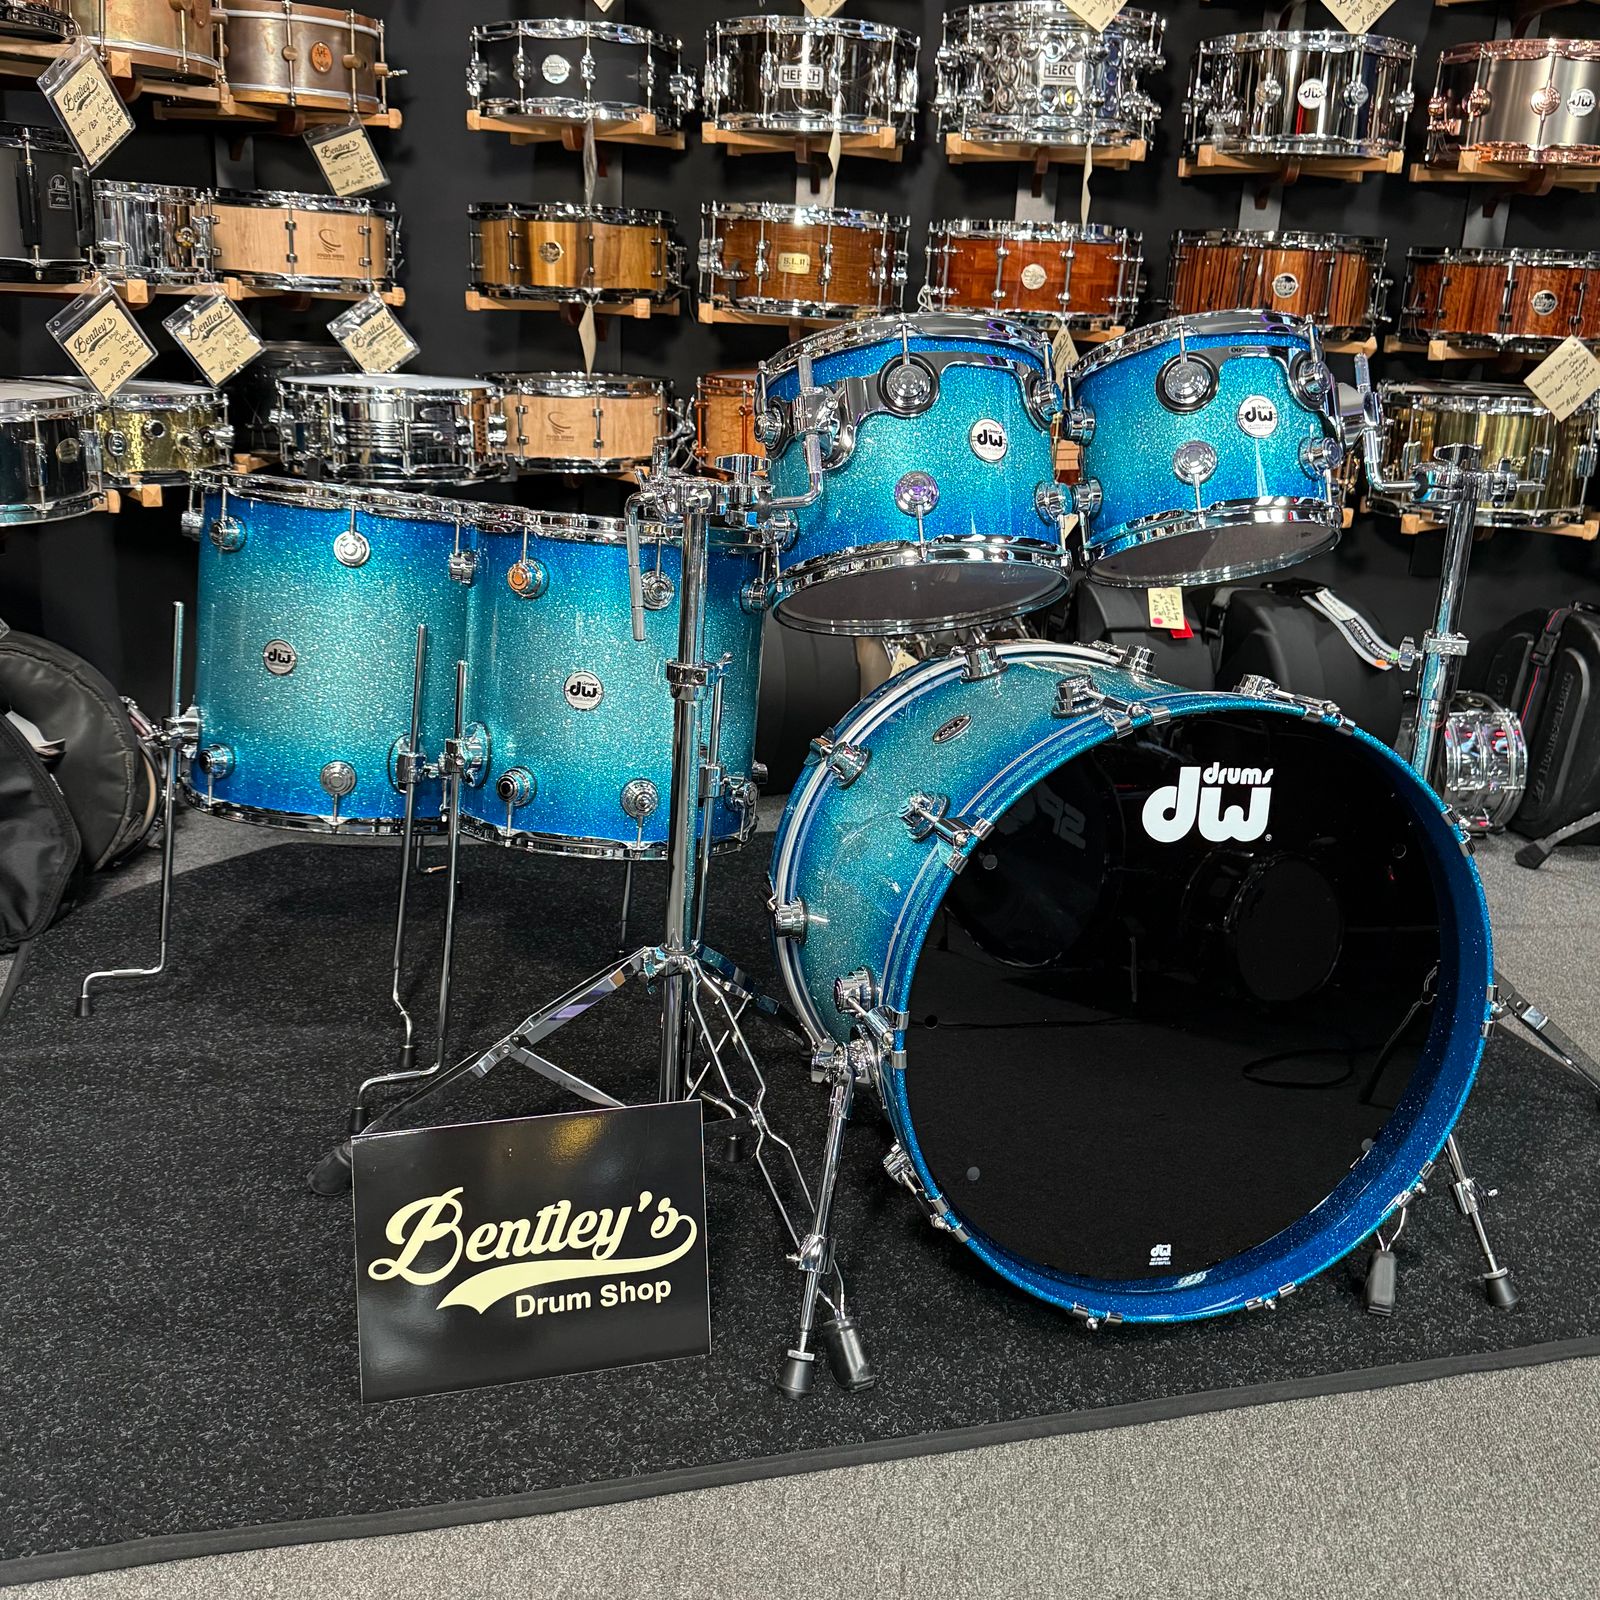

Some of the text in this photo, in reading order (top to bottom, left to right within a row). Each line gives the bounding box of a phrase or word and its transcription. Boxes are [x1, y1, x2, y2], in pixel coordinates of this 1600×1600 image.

[63, 76, 99, 114] Bentley's
[320, 139, 360, 159] Bentley's
[73, 317, 117, 357] Bentley's
[186, 304, 230, 344] Bentley's
[351, 312, 391, 350] Bentley's
[1244, 406, 1273, 423] dw
[976, 429, 1003, 447] dw
[267, 648, 292, 664] dw
[570, 681, 598, 698] dw
[1202, 761, 1274, 785] drums
[1142, 766, 1272, 843] dw
[367, 1186, 698, 1286] Bentley's
[515, 1279, 673, 1319] Drum Shop
